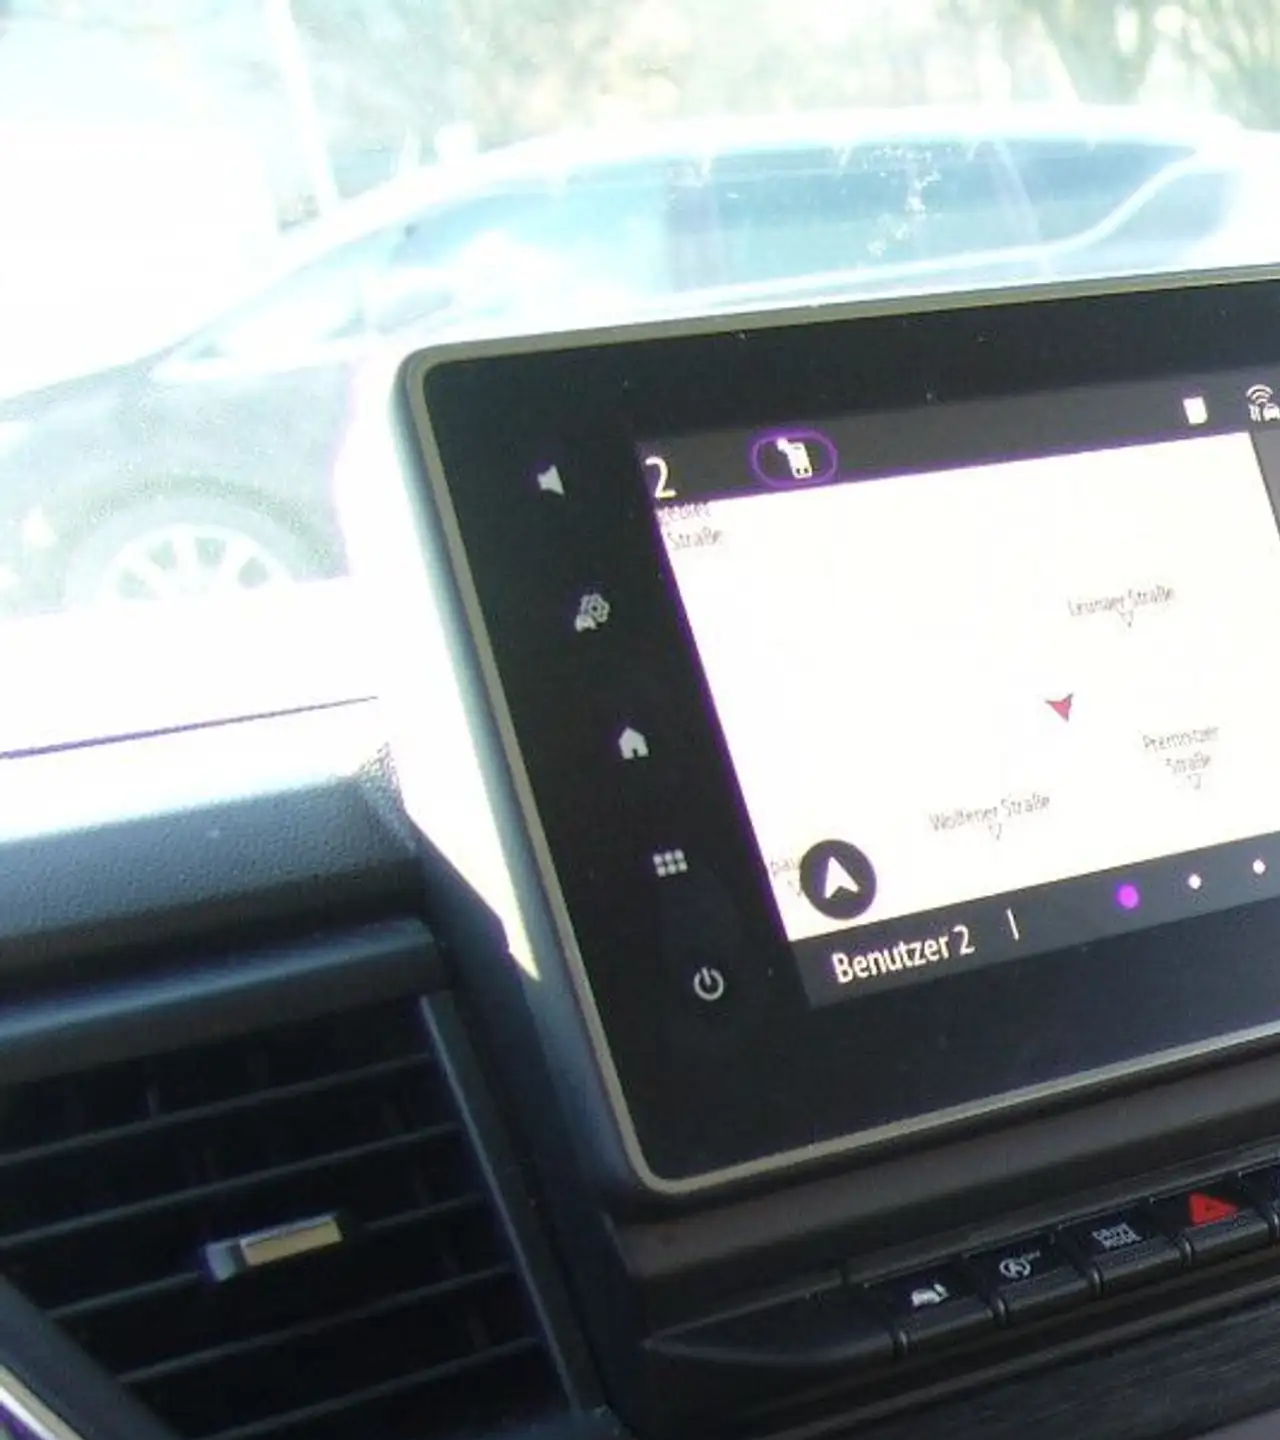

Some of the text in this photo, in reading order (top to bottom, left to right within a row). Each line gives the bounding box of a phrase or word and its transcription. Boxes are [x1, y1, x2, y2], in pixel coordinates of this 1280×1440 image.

[643, 455, 676, 499] 2
[831, 924, 976, 984] Benutzer 2
